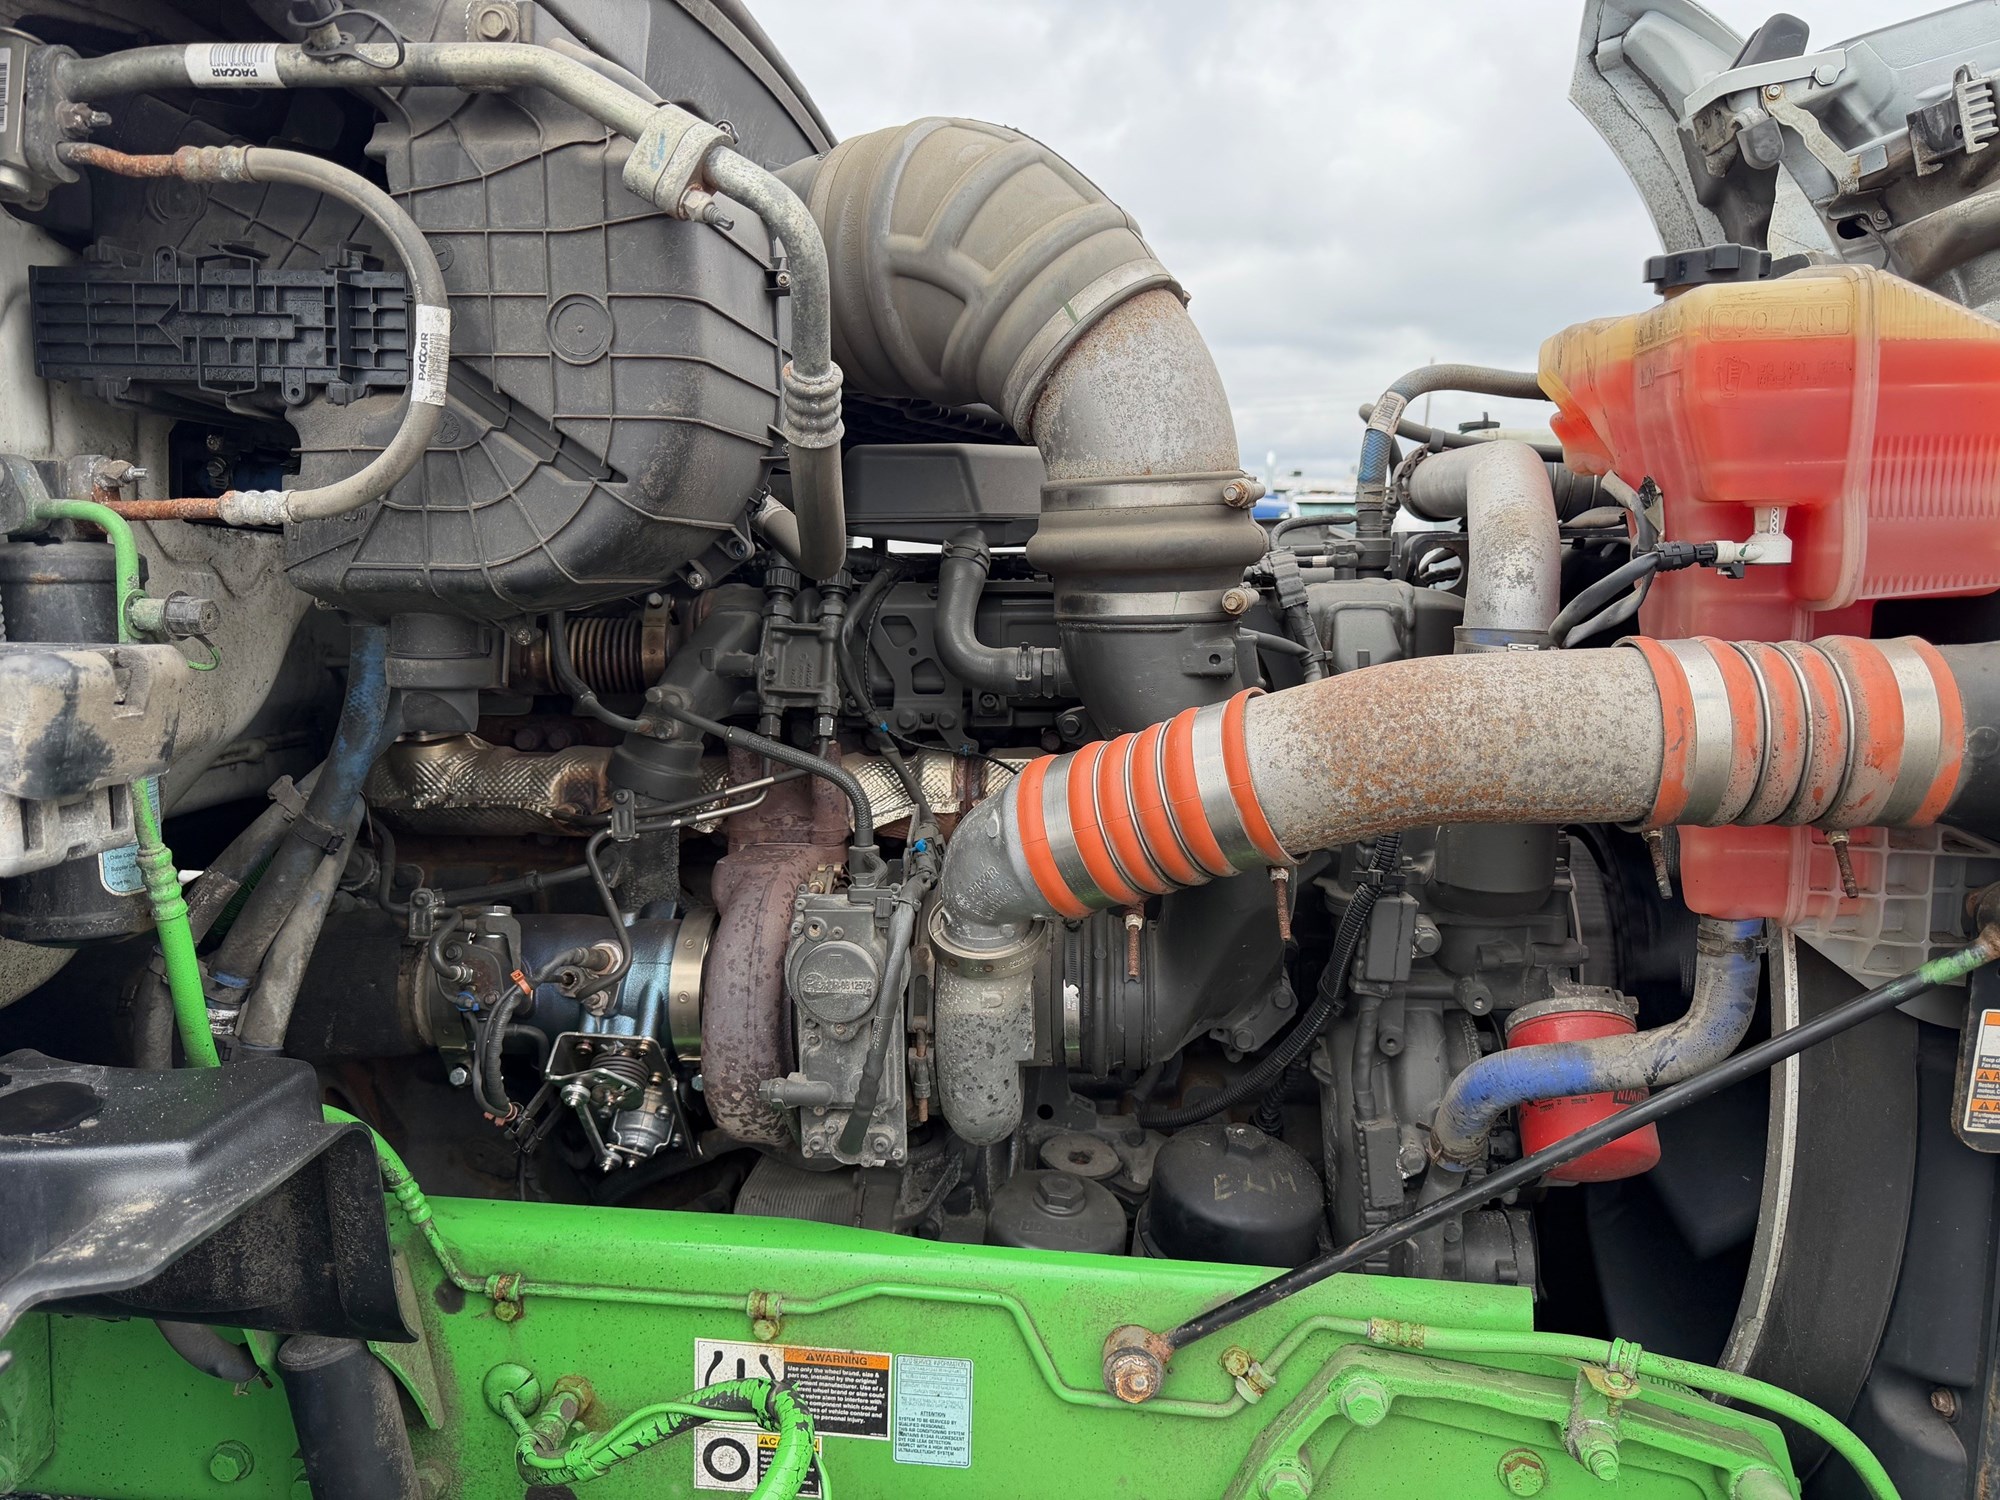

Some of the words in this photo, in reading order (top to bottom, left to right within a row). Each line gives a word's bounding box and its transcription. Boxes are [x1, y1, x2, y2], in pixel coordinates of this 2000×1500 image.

[212, 68, 258, 77] PACCAR
[1715, 307, 1841, 335] COOLANT
[418, 332, 428, 381] PACCAR
[816, 1354, 867, 1365] WARNING
